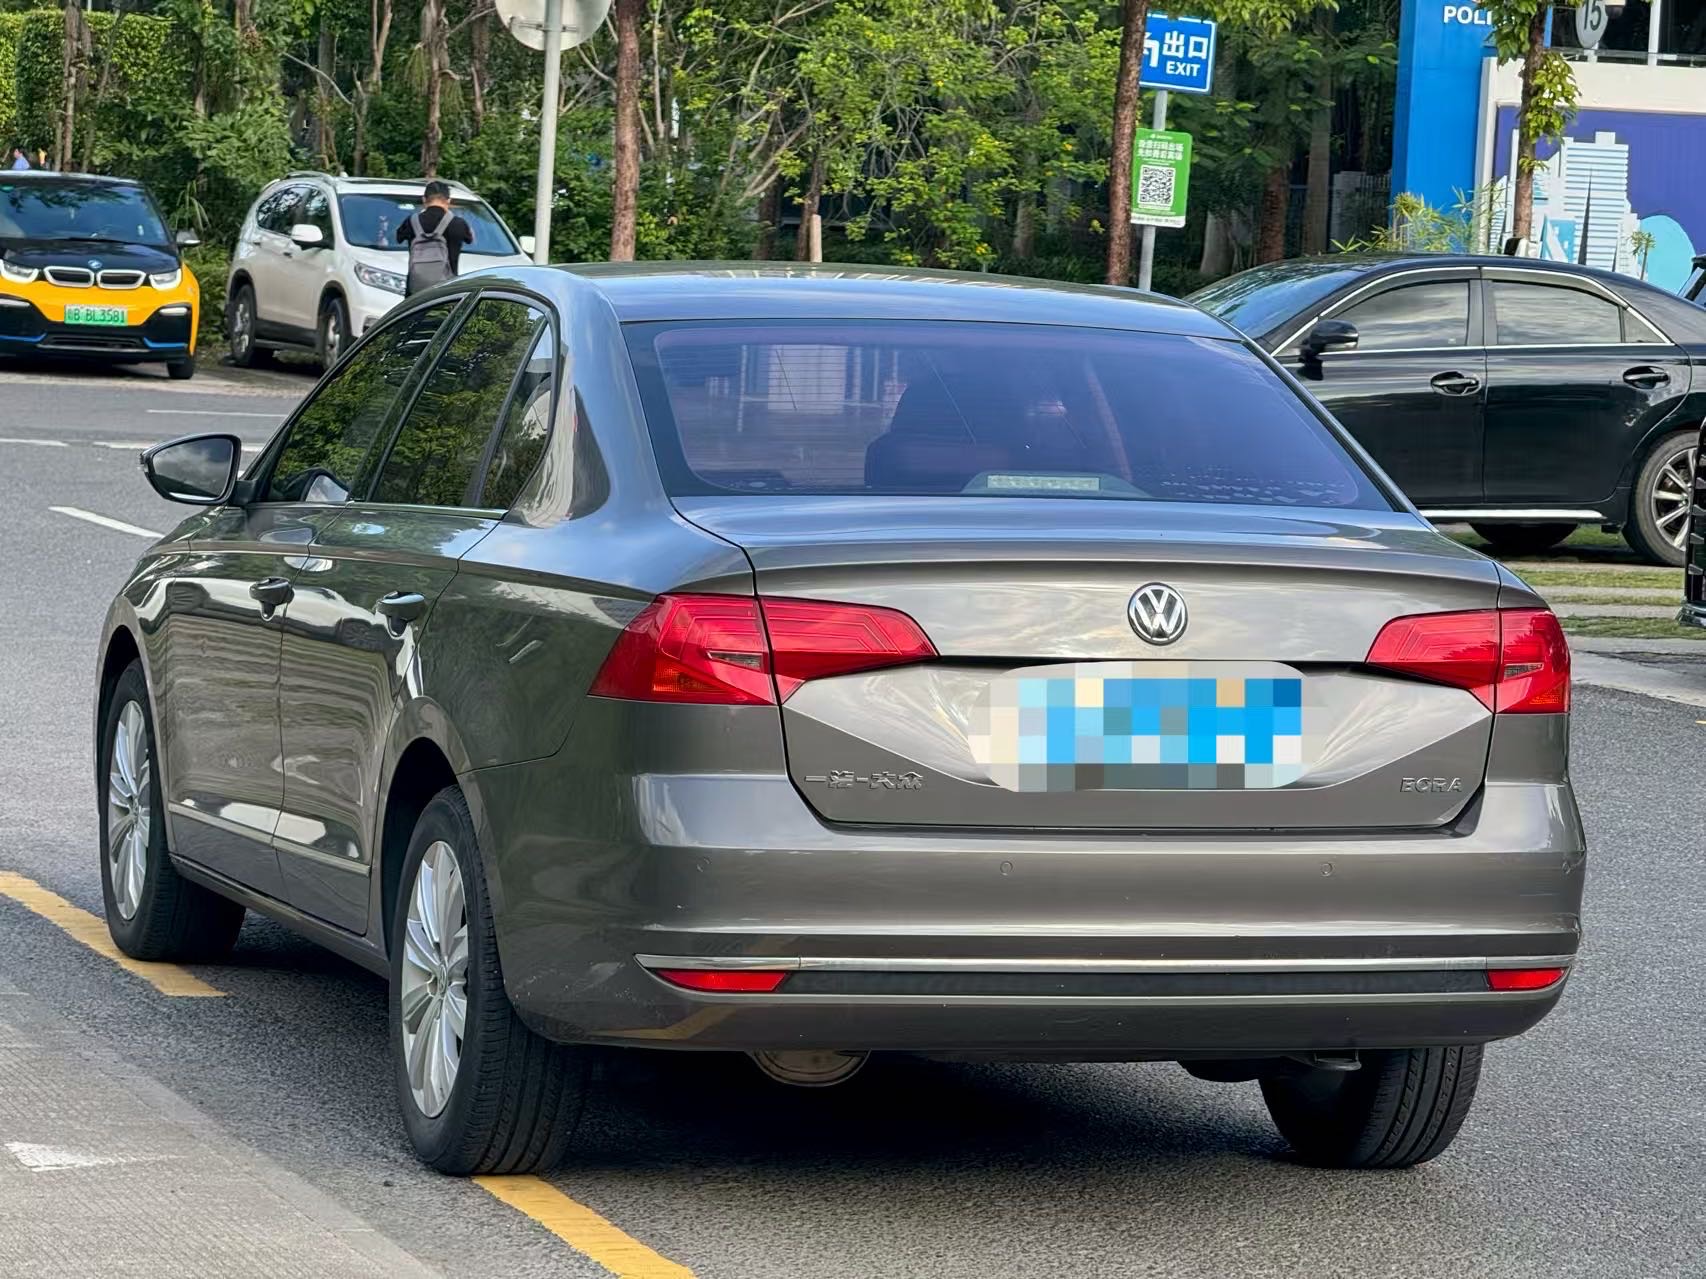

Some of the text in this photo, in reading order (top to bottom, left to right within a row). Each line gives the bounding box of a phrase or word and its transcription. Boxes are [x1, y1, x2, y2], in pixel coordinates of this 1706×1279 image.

[1443, 5, 1515, 26] POLI
[1584, 0, 1602, 31] 15
[1162, 30, 1209, 59] 出口
[1166, 60, 1201, 77] EXIT
[1399, 777, 1463, 793] BORA
